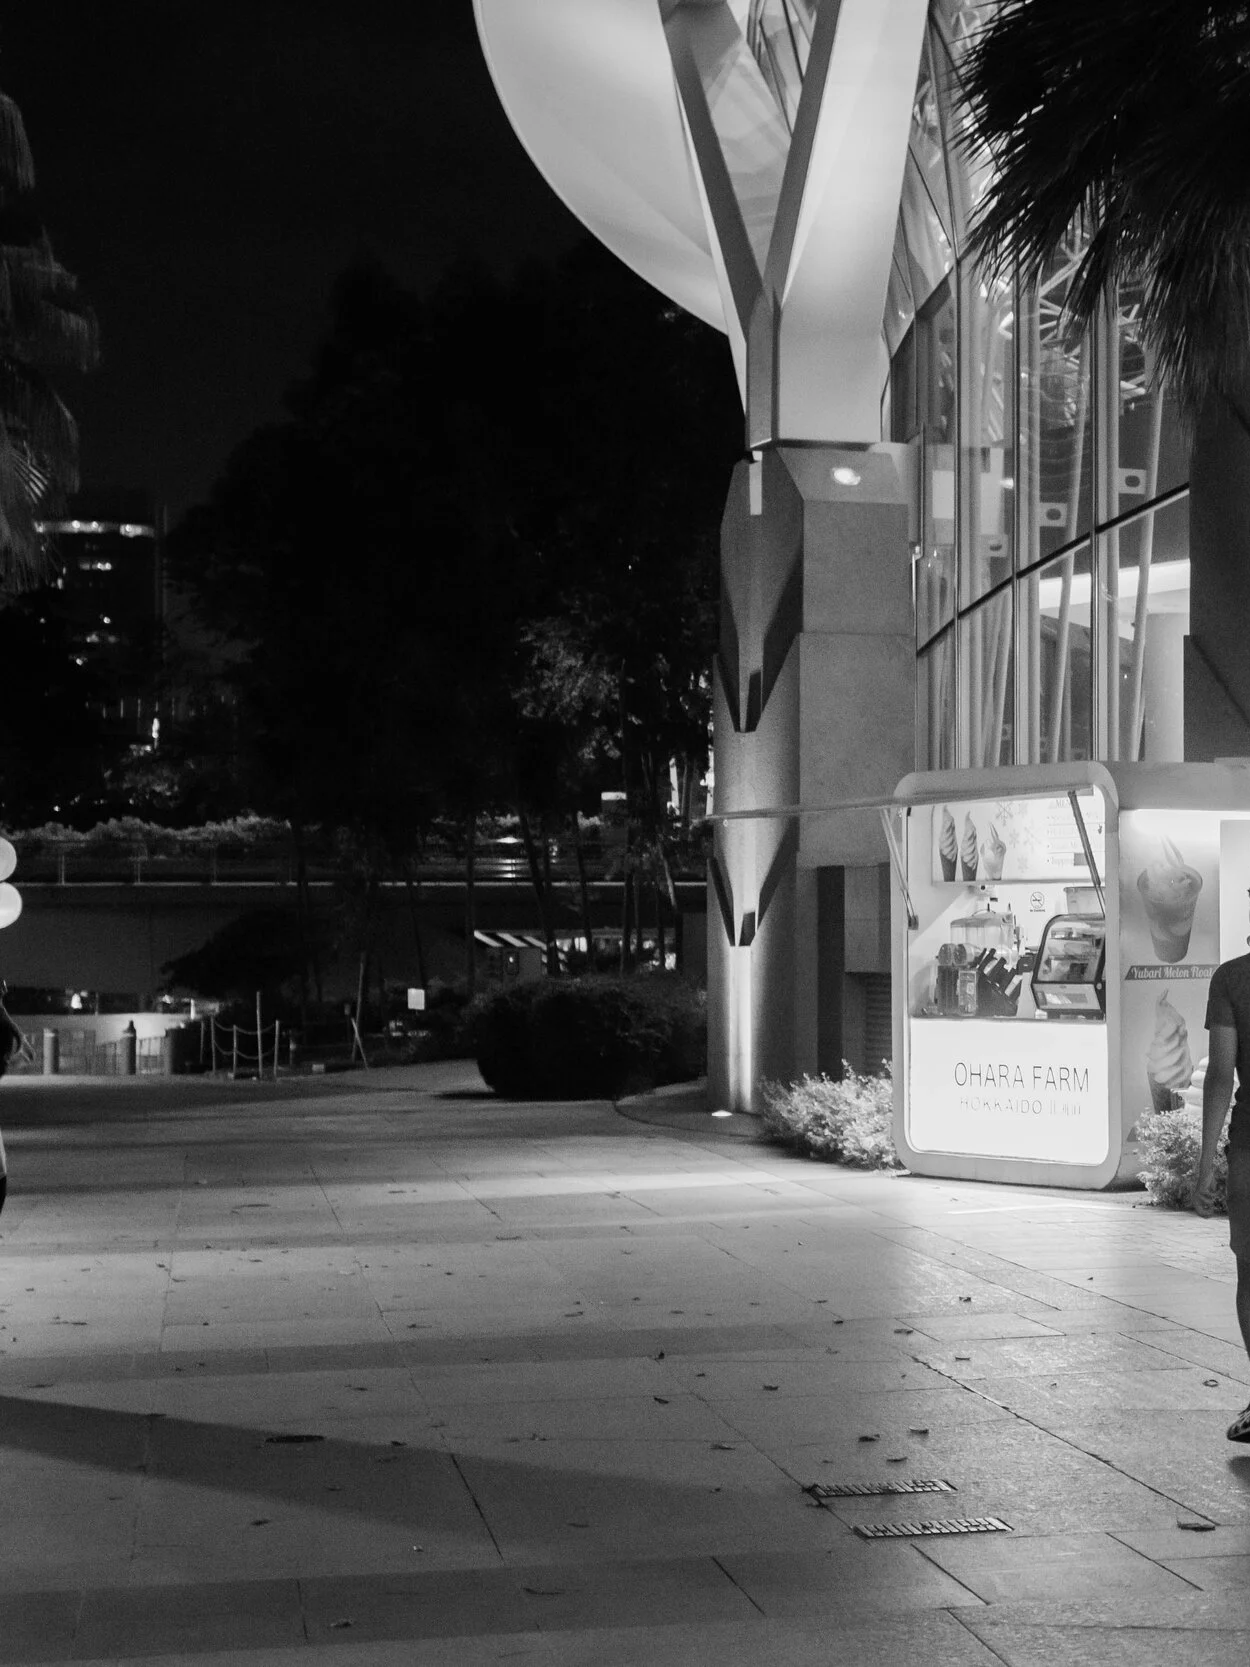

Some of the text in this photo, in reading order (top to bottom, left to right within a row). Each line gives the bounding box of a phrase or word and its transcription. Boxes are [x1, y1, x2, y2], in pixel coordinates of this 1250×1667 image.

[1131, 967, 1161, 979] Yubari
[1163, 966, 1189, 978] Melon
[954, 1062, 1089, 1092] OHARA FARM
[960, 1096, 1042, 1115] HOKKAIDO
